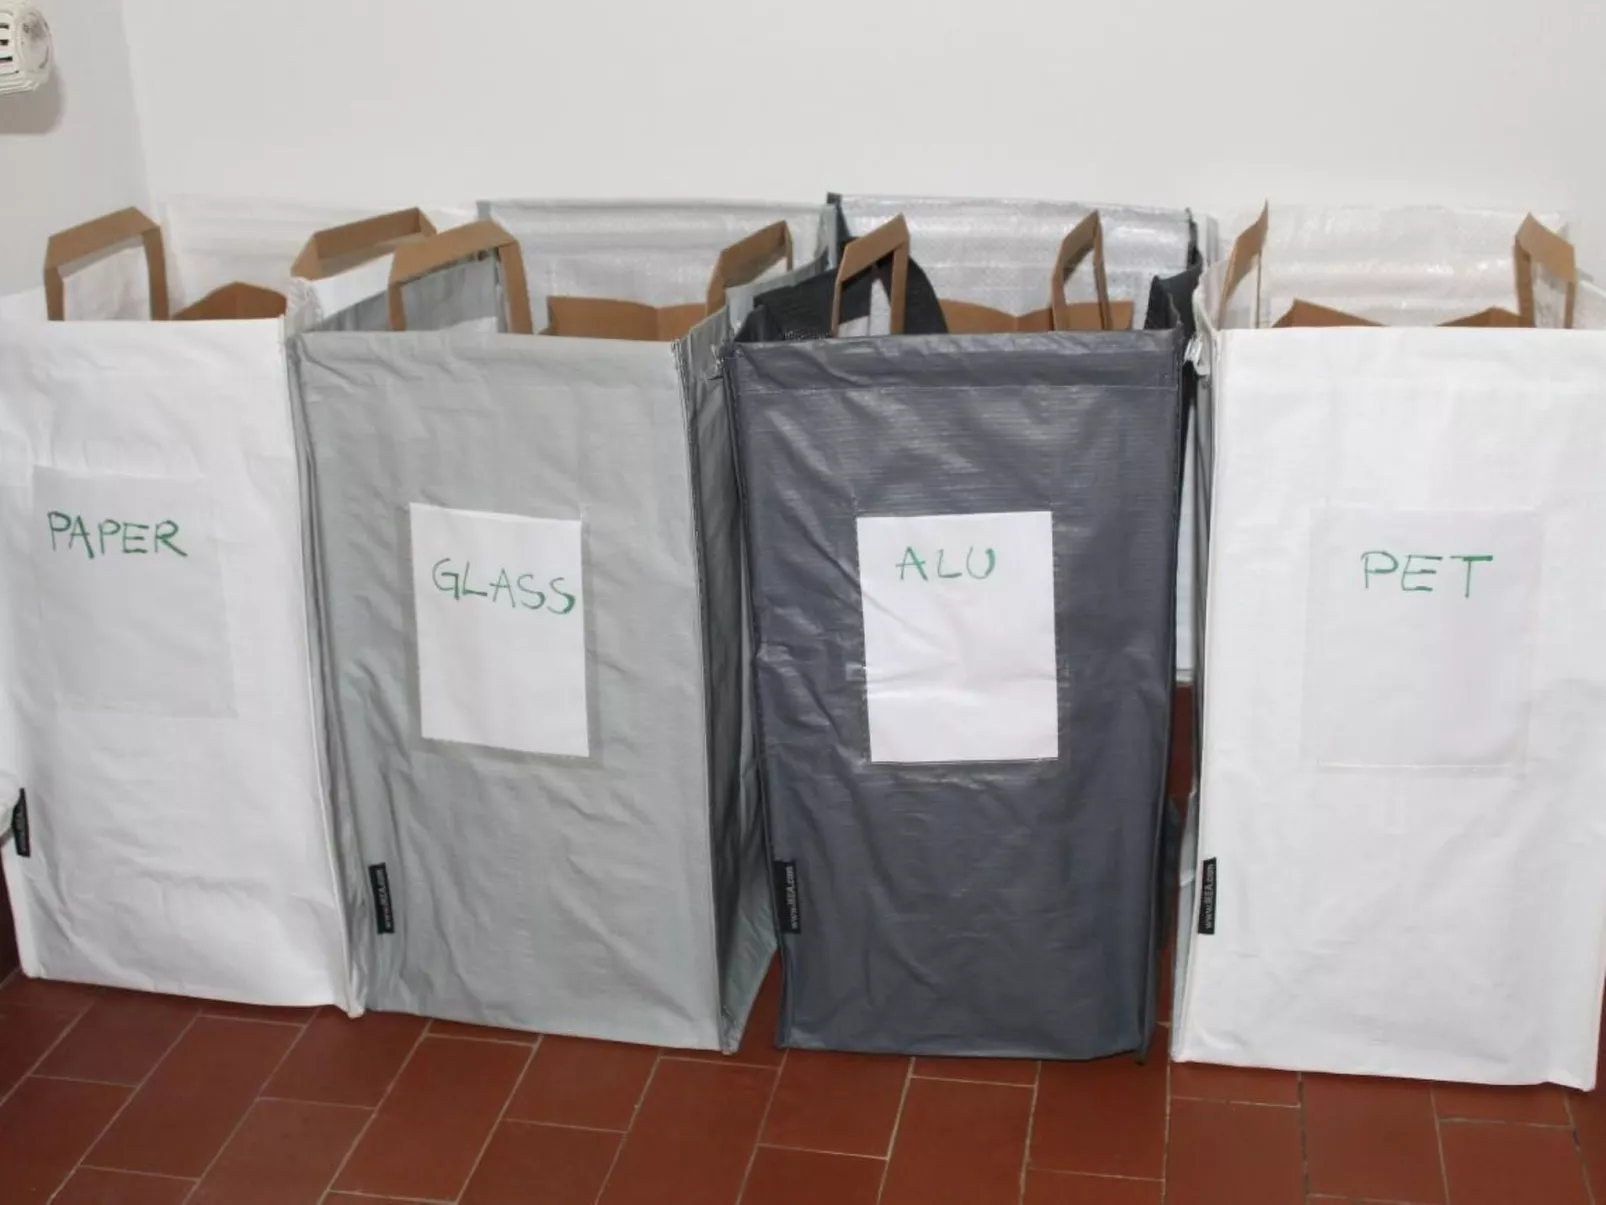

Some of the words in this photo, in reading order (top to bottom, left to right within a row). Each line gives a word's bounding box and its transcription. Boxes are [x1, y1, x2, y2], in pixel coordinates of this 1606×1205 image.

[47, 510, 189, 560] PAPER
[431, 556, 577, 616] GLASS
[894, 545, 996, 582] ALU
[1359, 549, 1494, 599] PET
